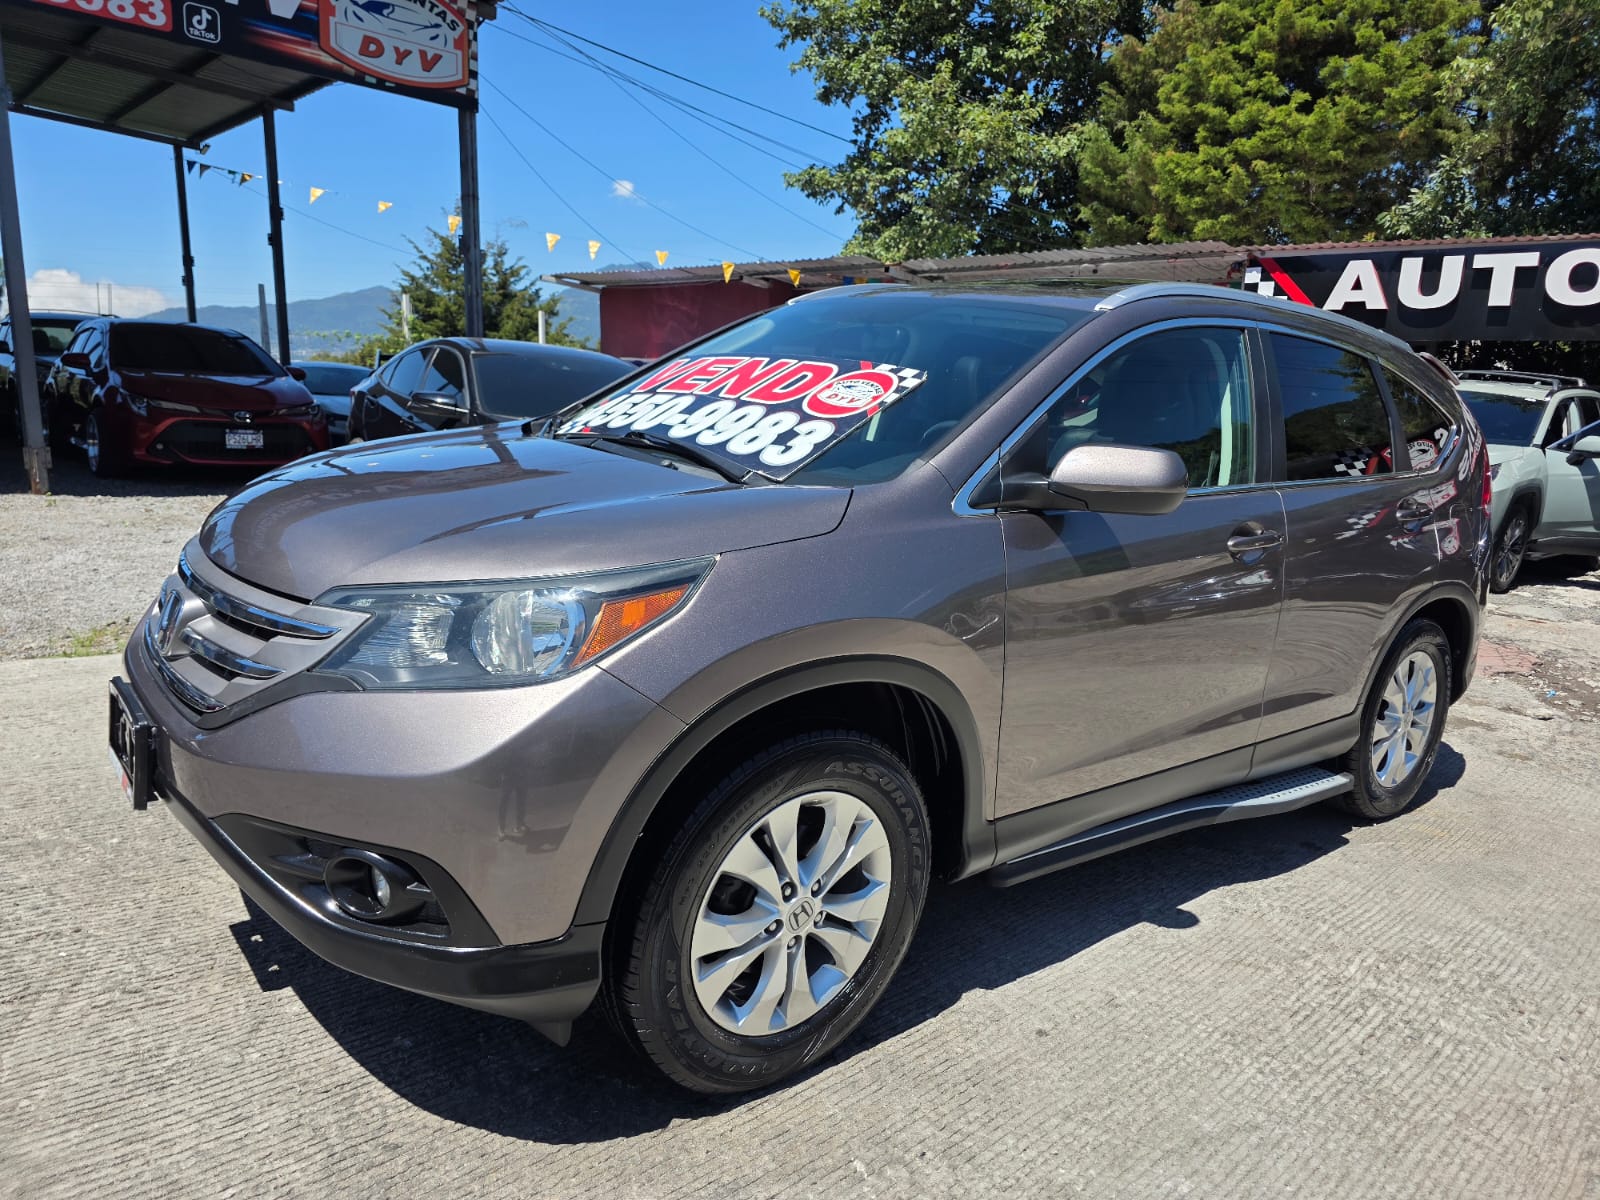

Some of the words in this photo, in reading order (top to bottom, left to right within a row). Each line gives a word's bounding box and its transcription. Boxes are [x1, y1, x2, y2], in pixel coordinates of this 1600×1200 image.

[189, 27, 216, 40] TikTok
[358, 34, 443, 73] DYV
[1322, 248, 1600, 311] AUTO
[823, 760, 923, 890] ASSURANCE
